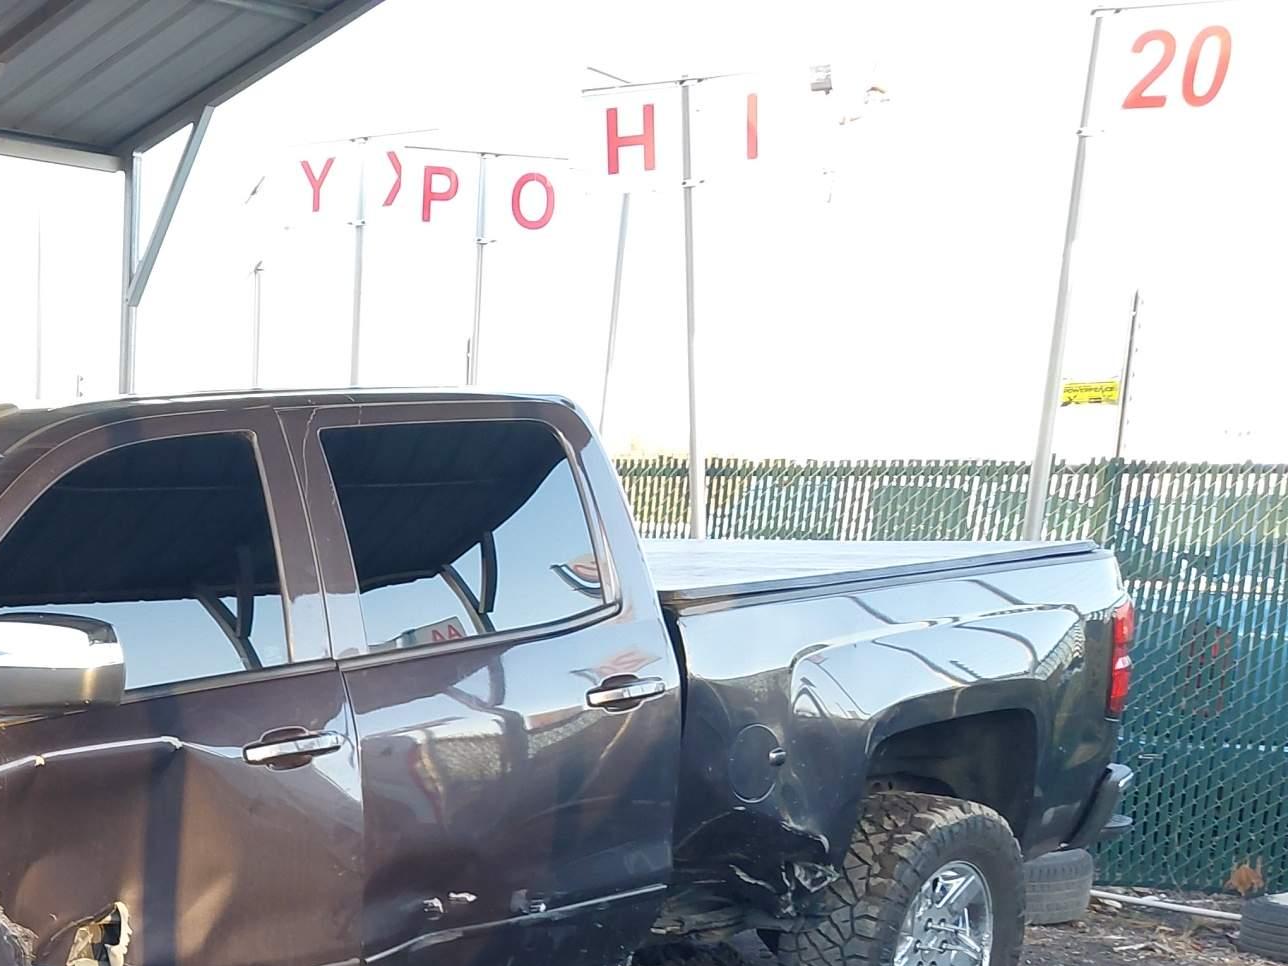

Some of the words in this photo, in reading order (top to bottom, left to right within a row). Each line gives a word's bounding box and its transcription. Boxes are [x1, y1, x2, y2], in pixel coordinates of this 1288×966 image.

[1122, 25, 1232, 110] 20
[606, 103, 655, 175] H
[300, 156, 336, 212] Y
[422, 165, 459, 222] P
[511, 172, 555, 230] O
